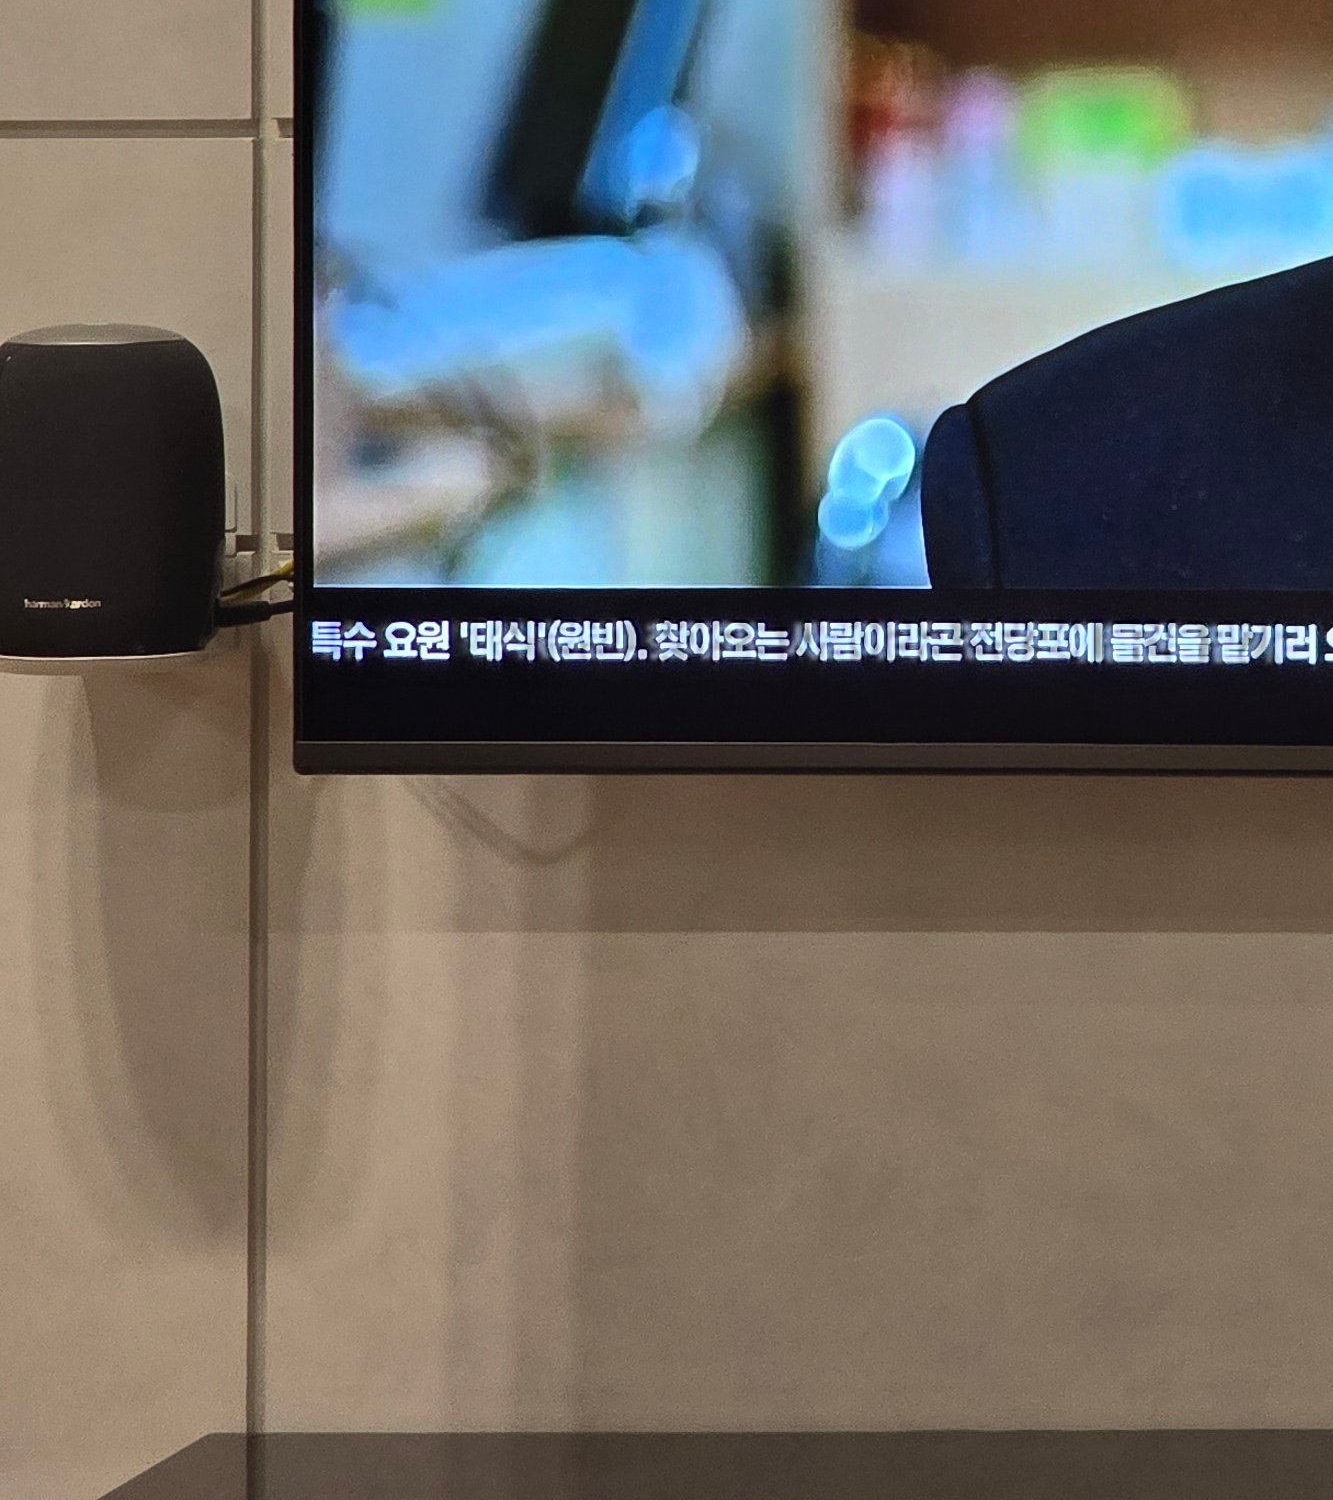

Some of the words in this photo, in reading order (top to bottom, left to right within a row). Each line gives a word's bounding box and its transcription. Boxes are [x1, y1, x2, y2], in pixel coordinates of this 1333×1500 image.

[24, 598, 63, 608] harman
[311, 620, 377, 661] 특수
[383, 620, 451, 661] 요원
[655, 621, 790, 662] 찾아오는
[796, 621, 964, 662] 사람이라곤
[970, 622, 1102, 663] 전당포에
[1111, 623, 1210, 664] 물건을
